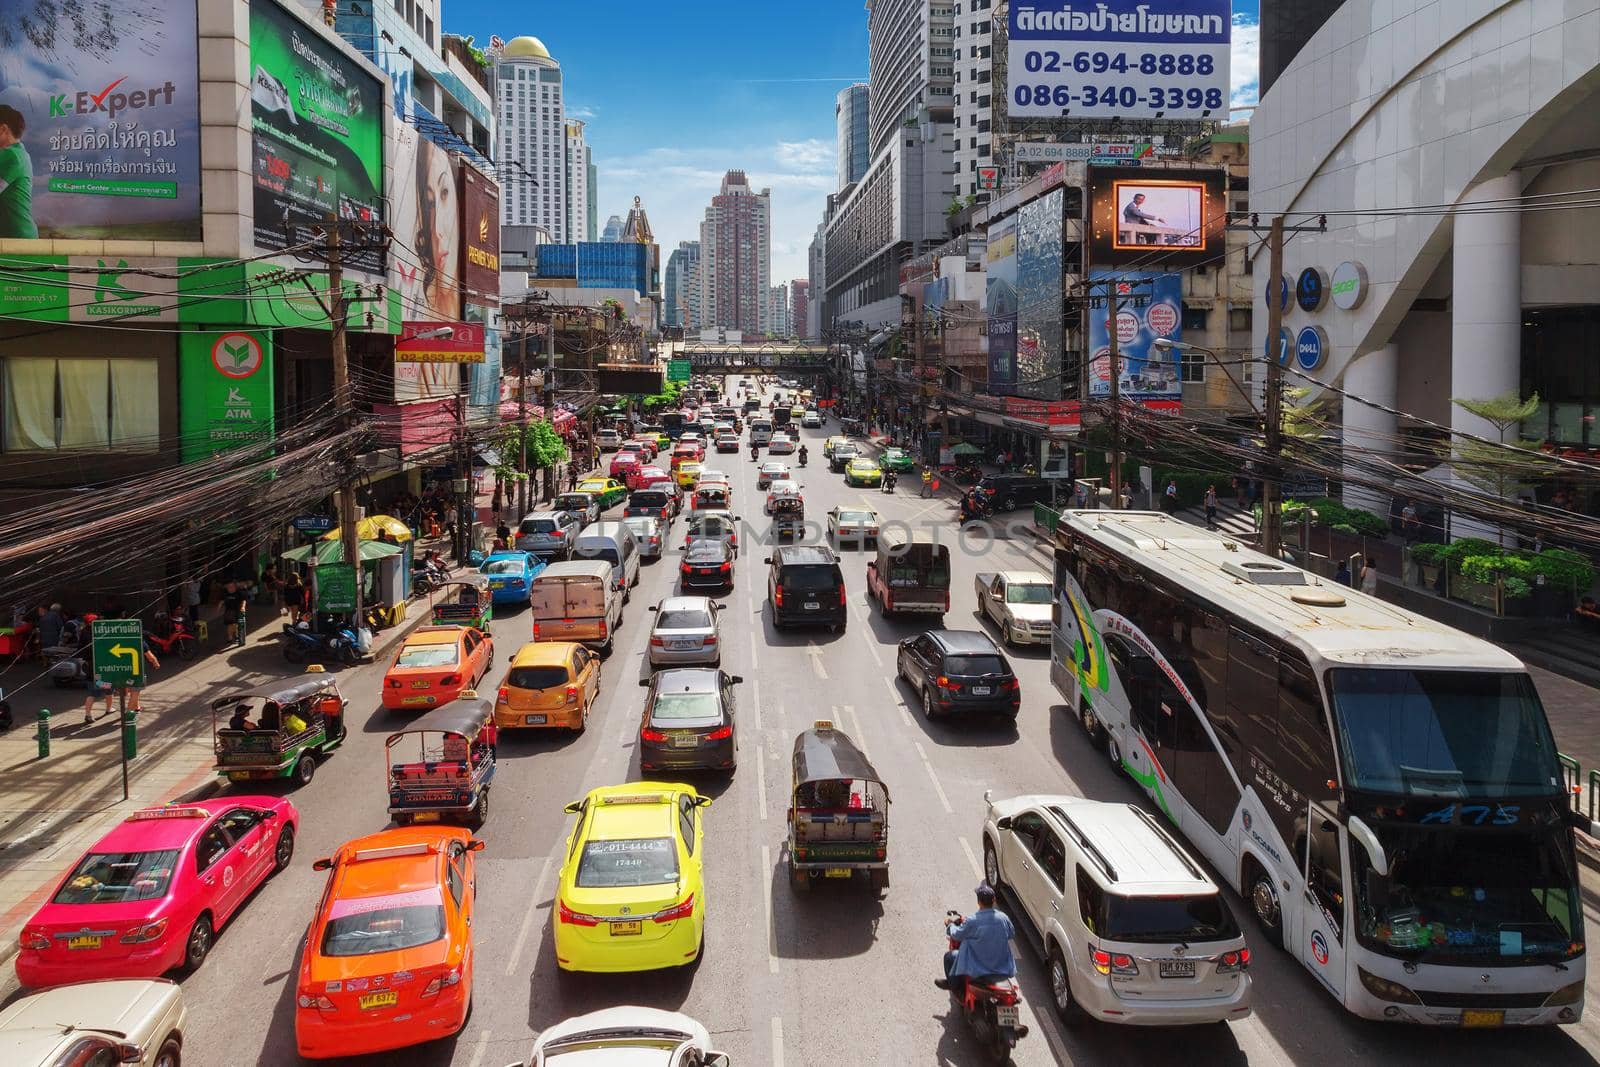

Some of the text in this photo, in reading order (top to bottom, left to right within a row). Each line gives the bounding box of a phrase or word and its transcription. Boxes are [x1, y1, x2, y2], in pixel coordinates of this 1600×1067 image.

[1016, 4, 1223, 34] ติดต่อป้ายโฆษณา
[1024, 51, 1214, 75] 02-694-8888
[49, 77, 176, 119] K-Expert
[1014, 85, 1223, 109] 086-340-3398
[49, 121, 177, 157] ช่วยคิดให้คุณ
[1093, 146, 1130, 154] SFETY
[1030, 147, 1090, 158] 02 694 8888
[49, 155, 177, 178] พร้อม ทุกเรื่องการเงิน
[86, 184, 109, 192] Center
[1299, 344, 1317, 353] DELL
[224, 408, 252, 418] ATM
[1252, 830, 1281, 862] SCANIA
